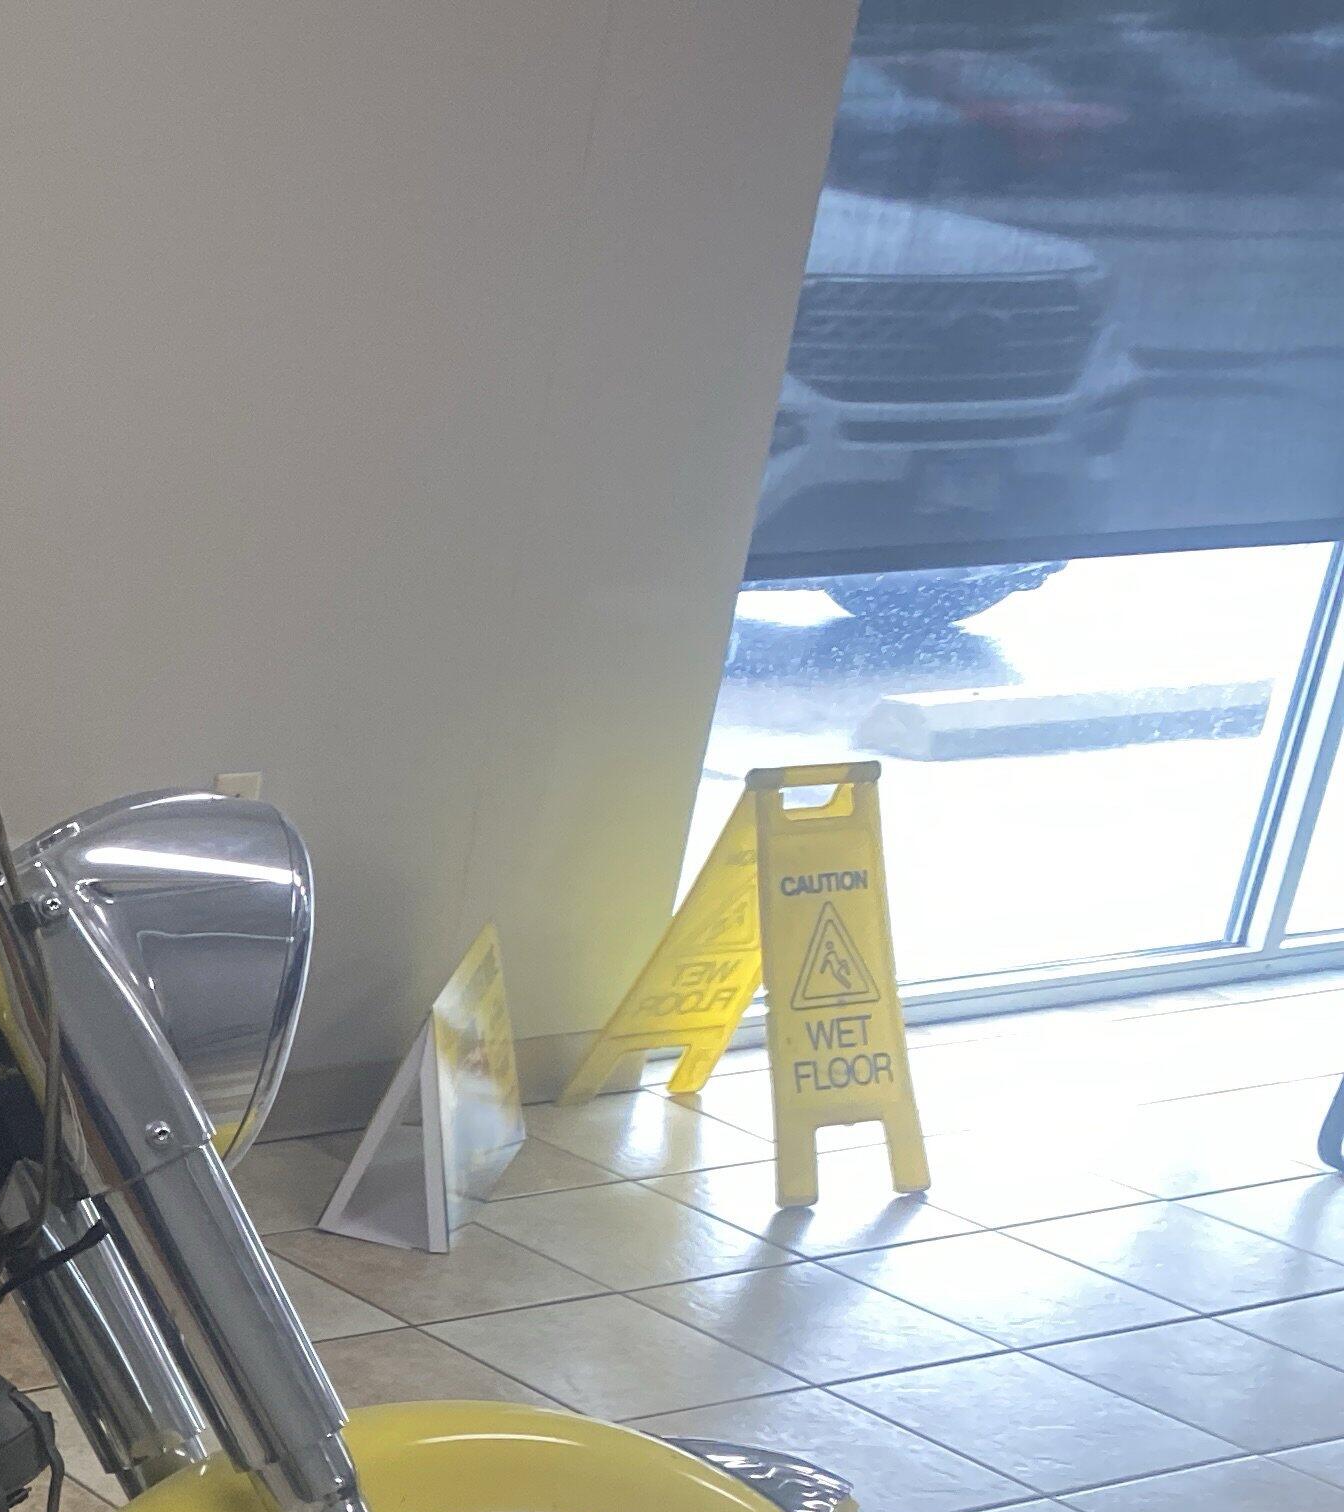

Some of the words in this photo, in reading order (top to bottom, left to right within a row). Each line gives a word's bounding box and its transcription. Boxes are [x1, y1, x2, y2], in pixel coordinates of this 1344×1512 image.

[780, 870, 868, 896] CAUTION
[805, 1014, 872, 1050] WET
[794, 1053, 894, 1093] FLOOR
